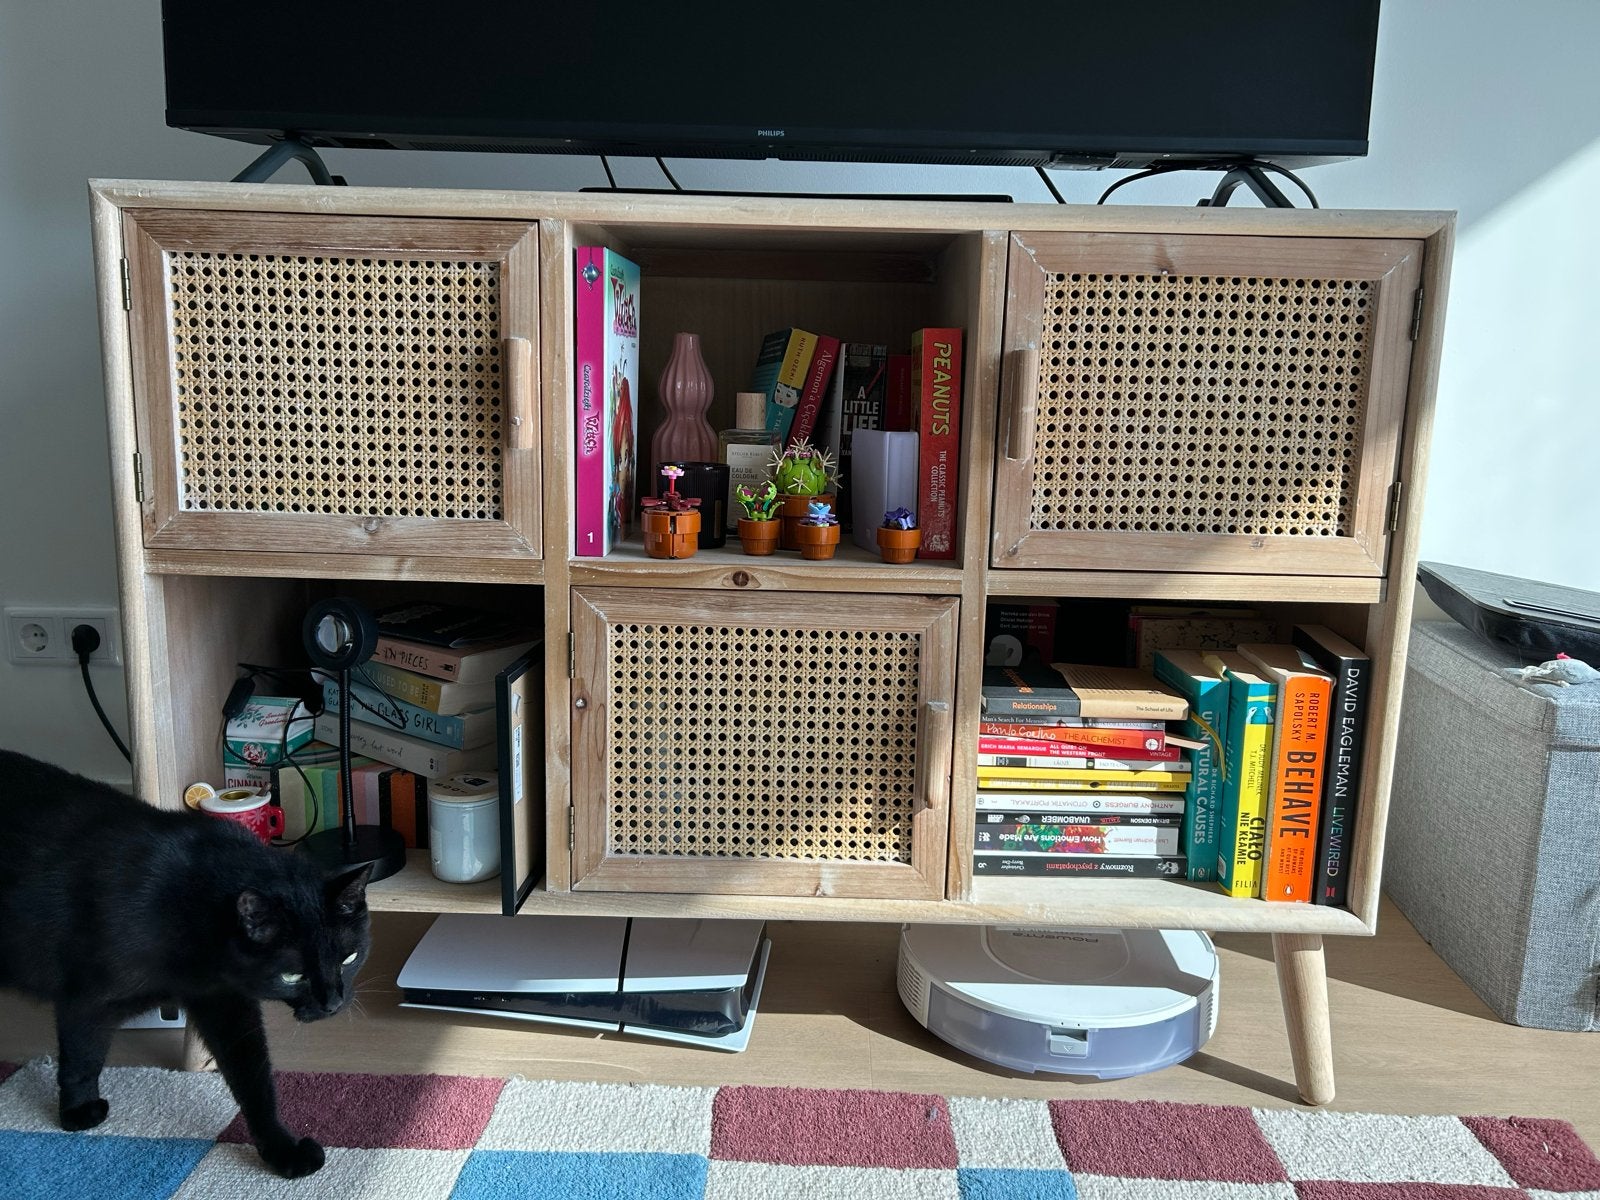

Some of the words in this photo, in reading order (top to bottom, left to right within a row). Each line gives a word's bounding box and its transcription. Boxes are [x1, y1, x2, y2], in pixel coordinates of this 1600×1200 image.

[757, 129, 785, 137] PHILIPS
[796, 337, 806, 358] RUTH
[789, 359, 801, 382] OZEKI
[857, 386, 866, 399] A
[931, 341, 953, 437] PEANUTS
[844, 400, 880, 415] LITTLE
[798, 404, 817, 440] Çiçekle
[843, 415, 879, 435] LIFE
[939, 449, 947, 463] THE
[930, 465, 938, 503] COLLECTION
[937, 463, 946, 488] CLASSIC
[936, 489, 945, 518] PEANUTS
[587, 532, 594, 543] 1
[384, 647, 397, 660] IN
[400, 651, 429, 670] PIECES
[377, 672, 395, 688] USED
[398, 681, 407, 692] TO
[410, 685, 420, 697] BE
[1344, 668, 1360, 712] DAVID
[1012, 701, 1057, 711] Relationships
[1306, 693, 1320, 728] ROBERT
[377, 702, 409, 723] GLASS
[414, 714, 442, 735] GIRL
[1291, 693, 1305, 741] SAPOLSKY
[985, 723, 1015, 736] Paulo
[1018, 726, 1056, 740] Coelho
[1064, 732, 1078, 740] THE
[1080, 734, 1127, 745] ALCHEMIST
[1305, 732, 1316, 743] M.
[1259, 744, 1266, 753] DR
[1335, 717, 1355, 797] EAGLEMAN
[1211, 768, 1218, 777] DR
[1247, 760, 1256, 789] MITCHELL
[228, 778, 269, 789] CINNAM
[1209, 779, 1217, 809] RICHARD
[1279, 751, 1317, 838] BEHAVE
[1041, 815, 1091, 824] UNABOMBER
[1194, 796, 1208, 844] CAUSES
[1207, 811, 1216, 844] SHEPHERD
[1239, 812, 1250, 827] NIE
[999, 833, 1022, 842] Made
[1023, 834, 1039, 842] Are
[1040, 834, 1080, 844] Emotions
[1082, 835, 1101, 844] How
[1247, 817, 1265, 861] CIAŁO
[1327, 807, 1346, 877] LIVEWIRED
[1236, 831, 1248, 865] KŁAMIE
[1045, 862, 1093, 872] psychopatami
[1100, 862, 1134, 873] Rozmowy
[1234, 880, 1258, 888] FILIA
